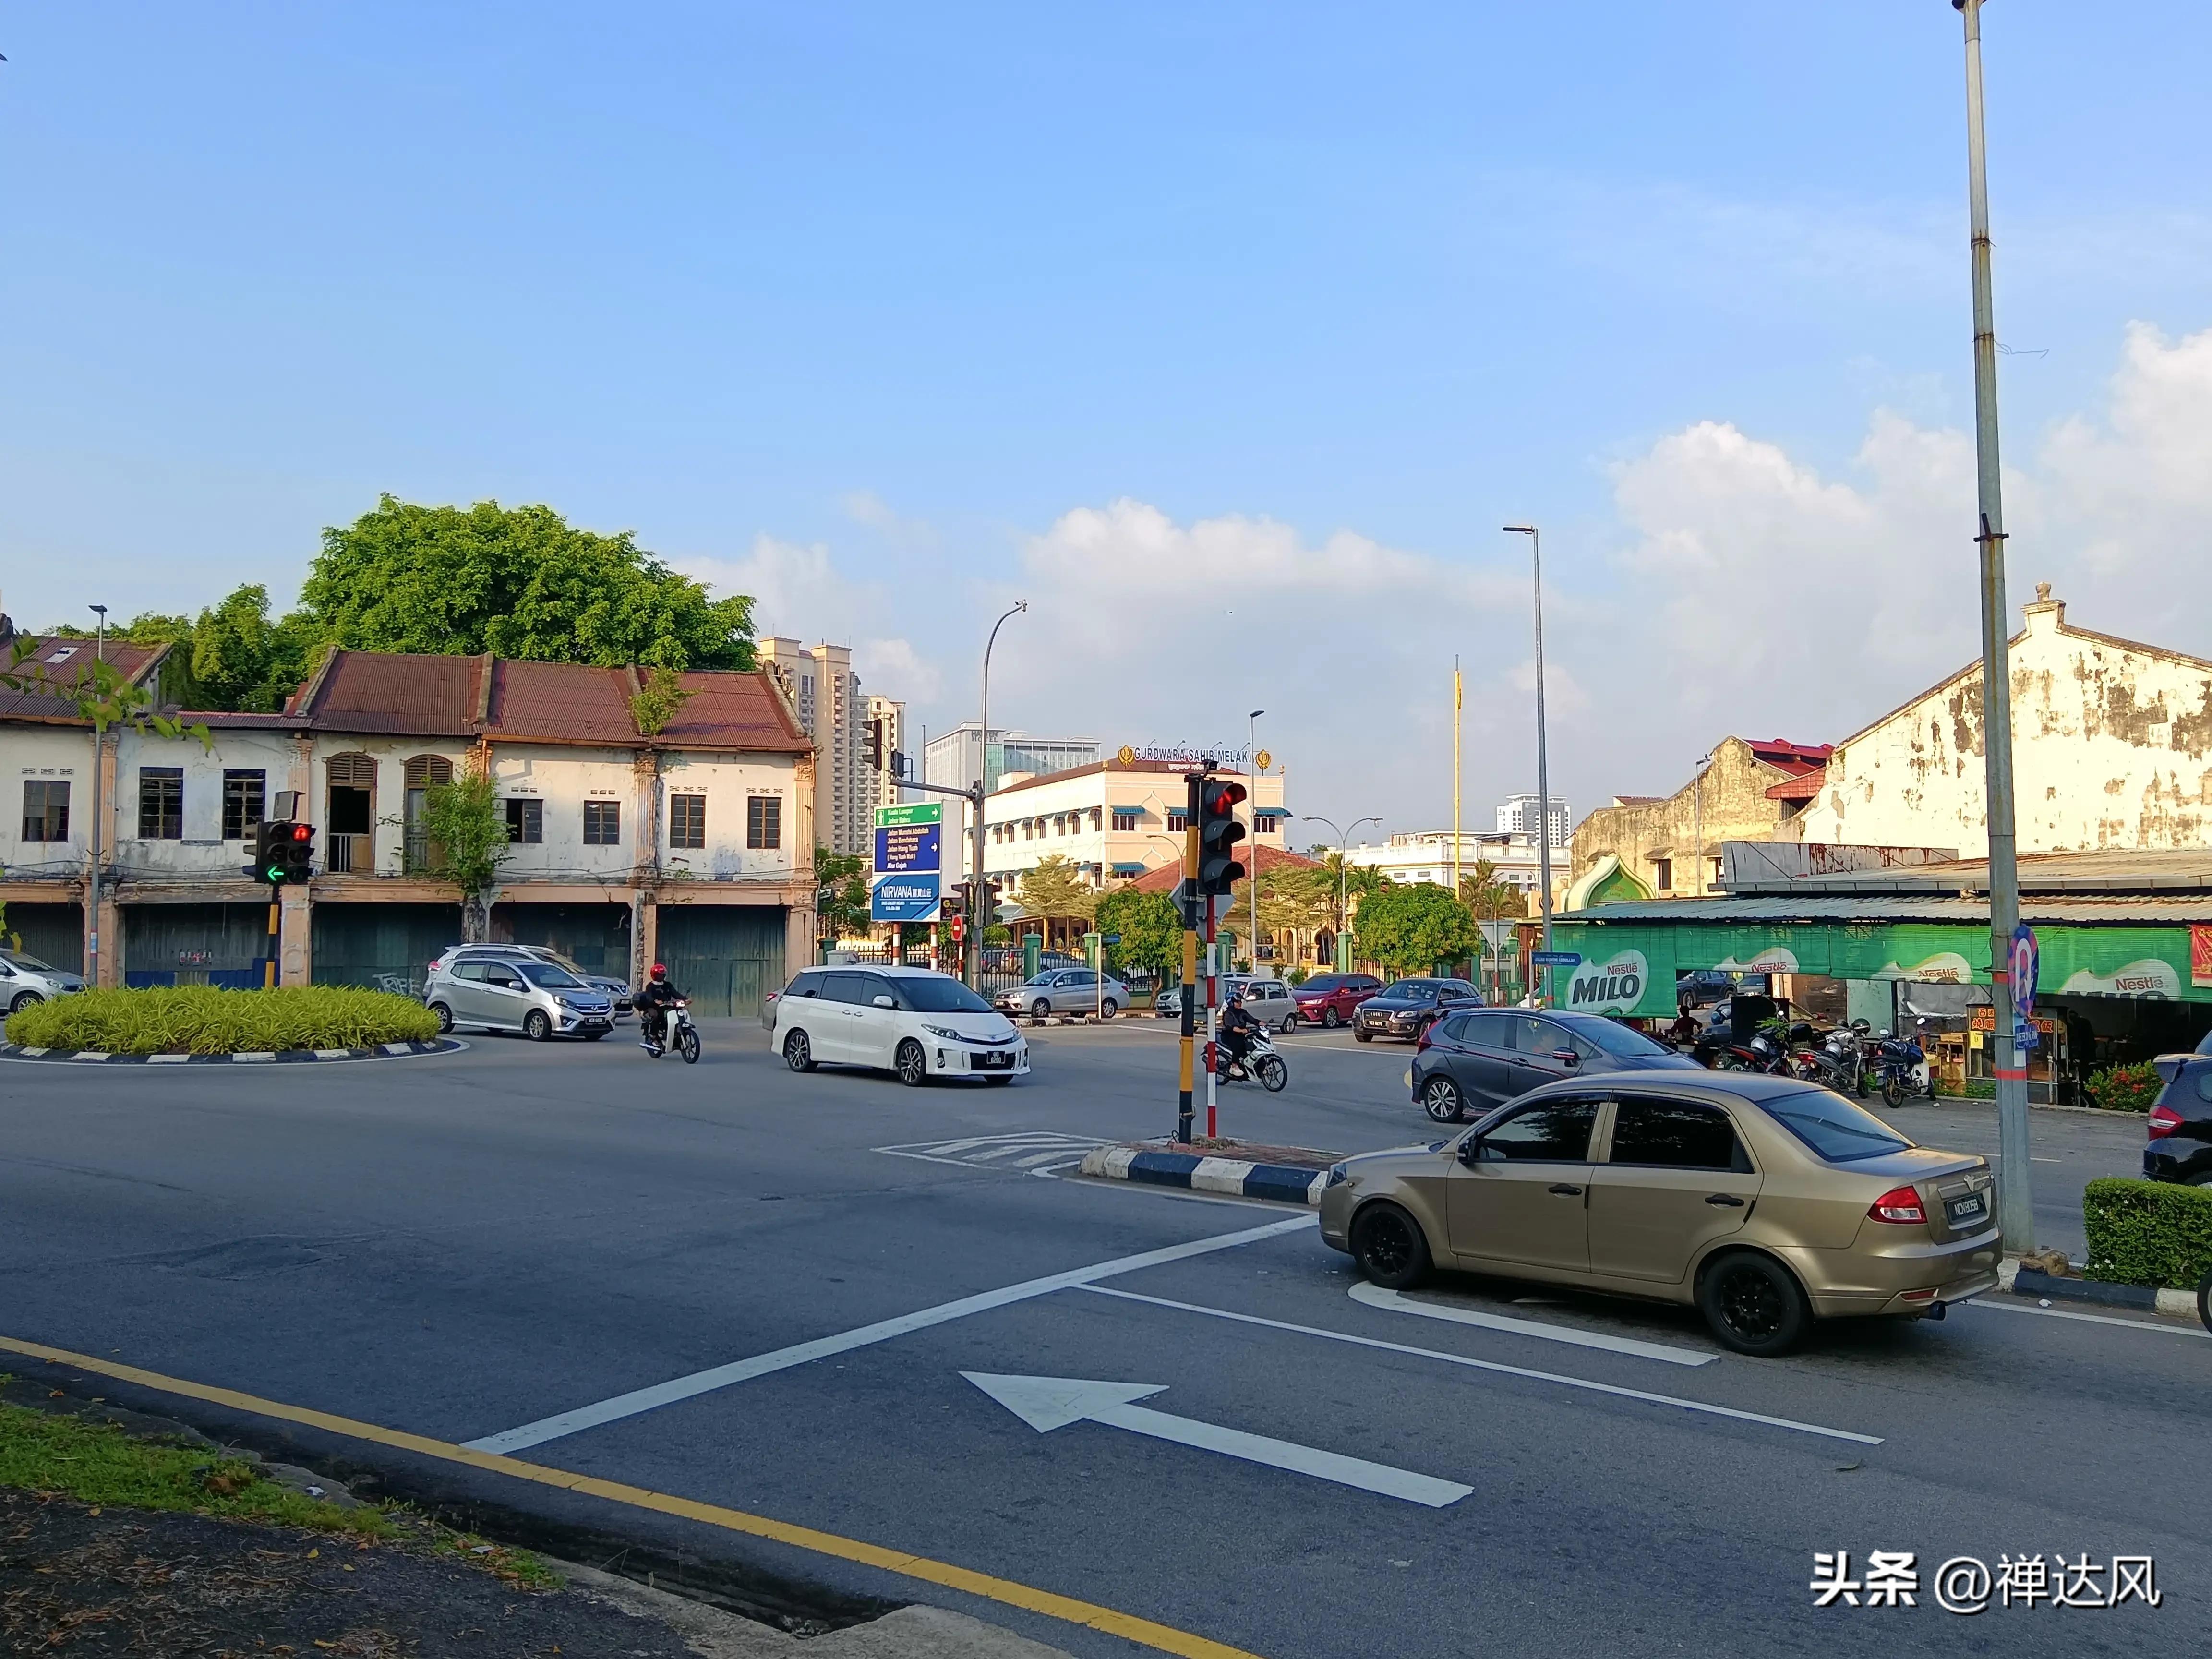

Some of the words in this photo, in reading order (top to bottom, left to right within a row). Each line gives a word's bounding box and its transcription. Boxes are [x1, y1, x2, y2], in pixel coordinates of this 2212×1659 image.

[1134, 747, 1185, 761] GURDWARA
[1188, 749, 1214, 762] SAHIB
[881, 885, 912, 898] NIRVANA
[1572, 974, 1640, 1004] MILO
